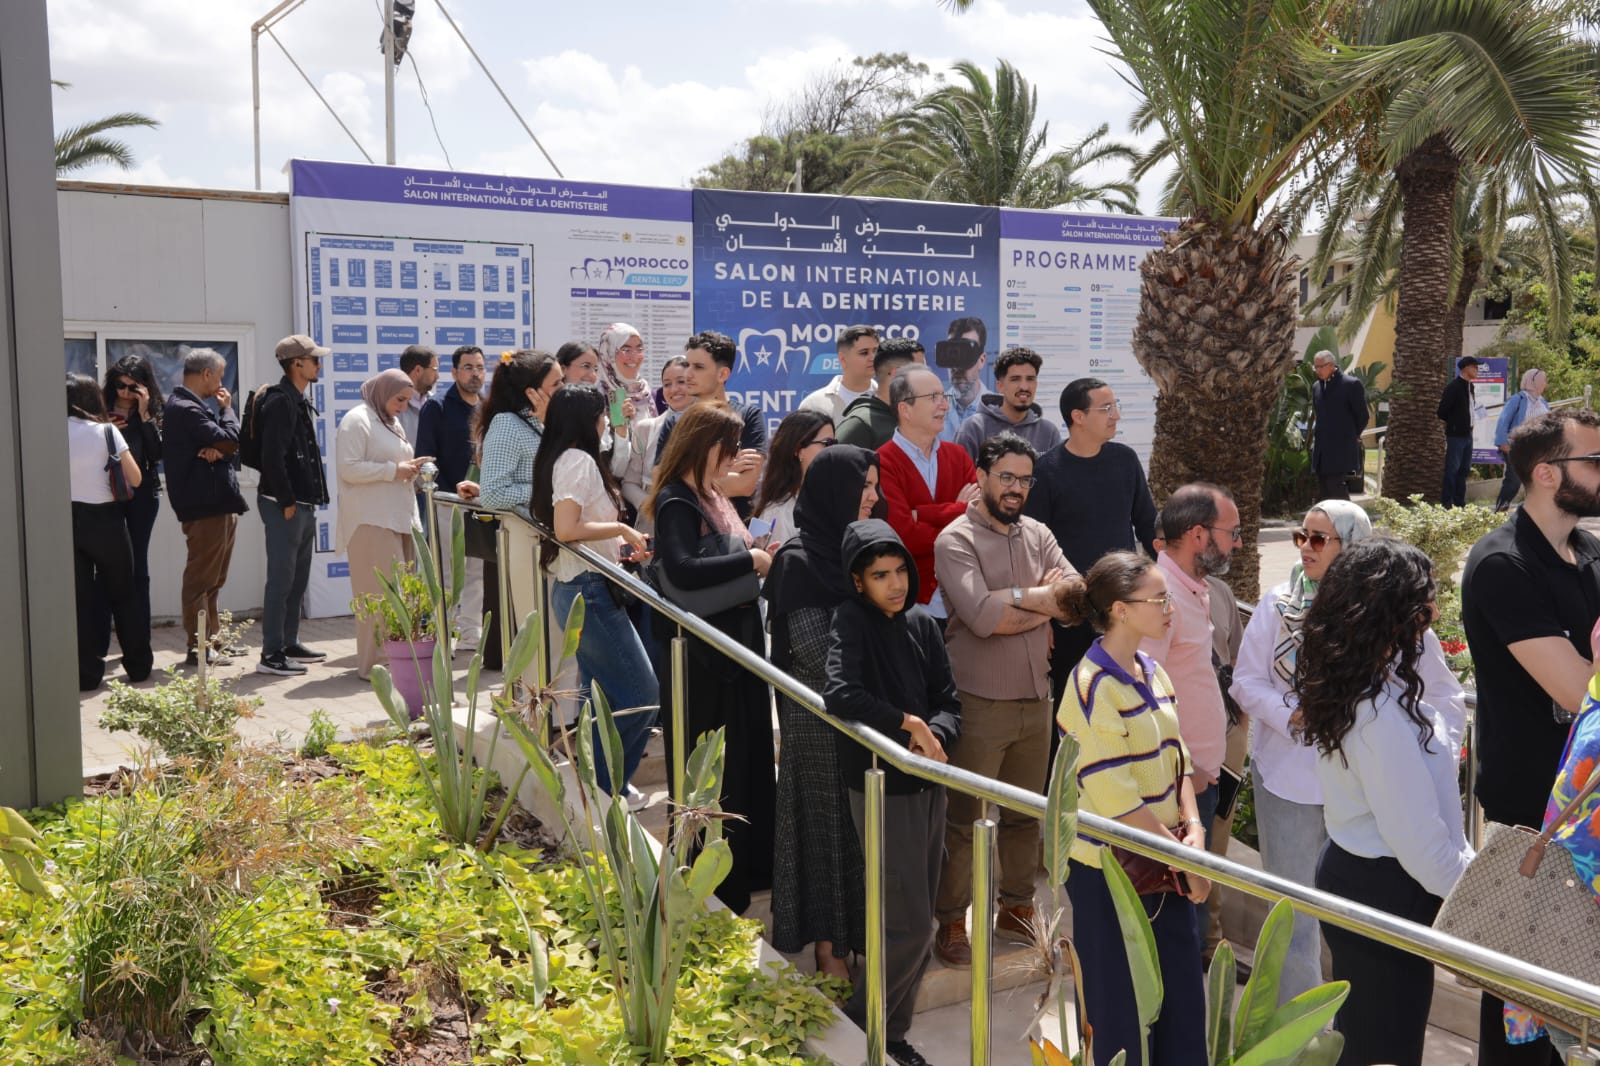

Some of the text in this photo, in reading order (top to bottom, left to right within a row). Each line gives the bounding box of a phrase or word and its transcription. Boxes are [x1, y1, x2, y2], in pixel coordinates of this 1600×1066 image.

[505, 184, 556, 195] الدولي
[403, 189, 608, 212] SALON INTERNATIONAL DE LA DENTISTERIE
[715, 211, 982, 237] المعرض الدولي
[726, 232, 847, 254] الأسنان
[1062, 230, 1083, 238] SALON
[1084, 231, 1131, 240] INTERNATIONAL
[614, 256, 689, 270] MOROCCO
[1013, 249, 1137, 272] PROGRAMME
[714, 262, 982, 287] SALON INTERNATIONAL
[1006, 280, 1016, 288] 07
[742, 290, 965, 311] DE LA DENTISTERIE
[1006, 301, 1017, 310] 08
